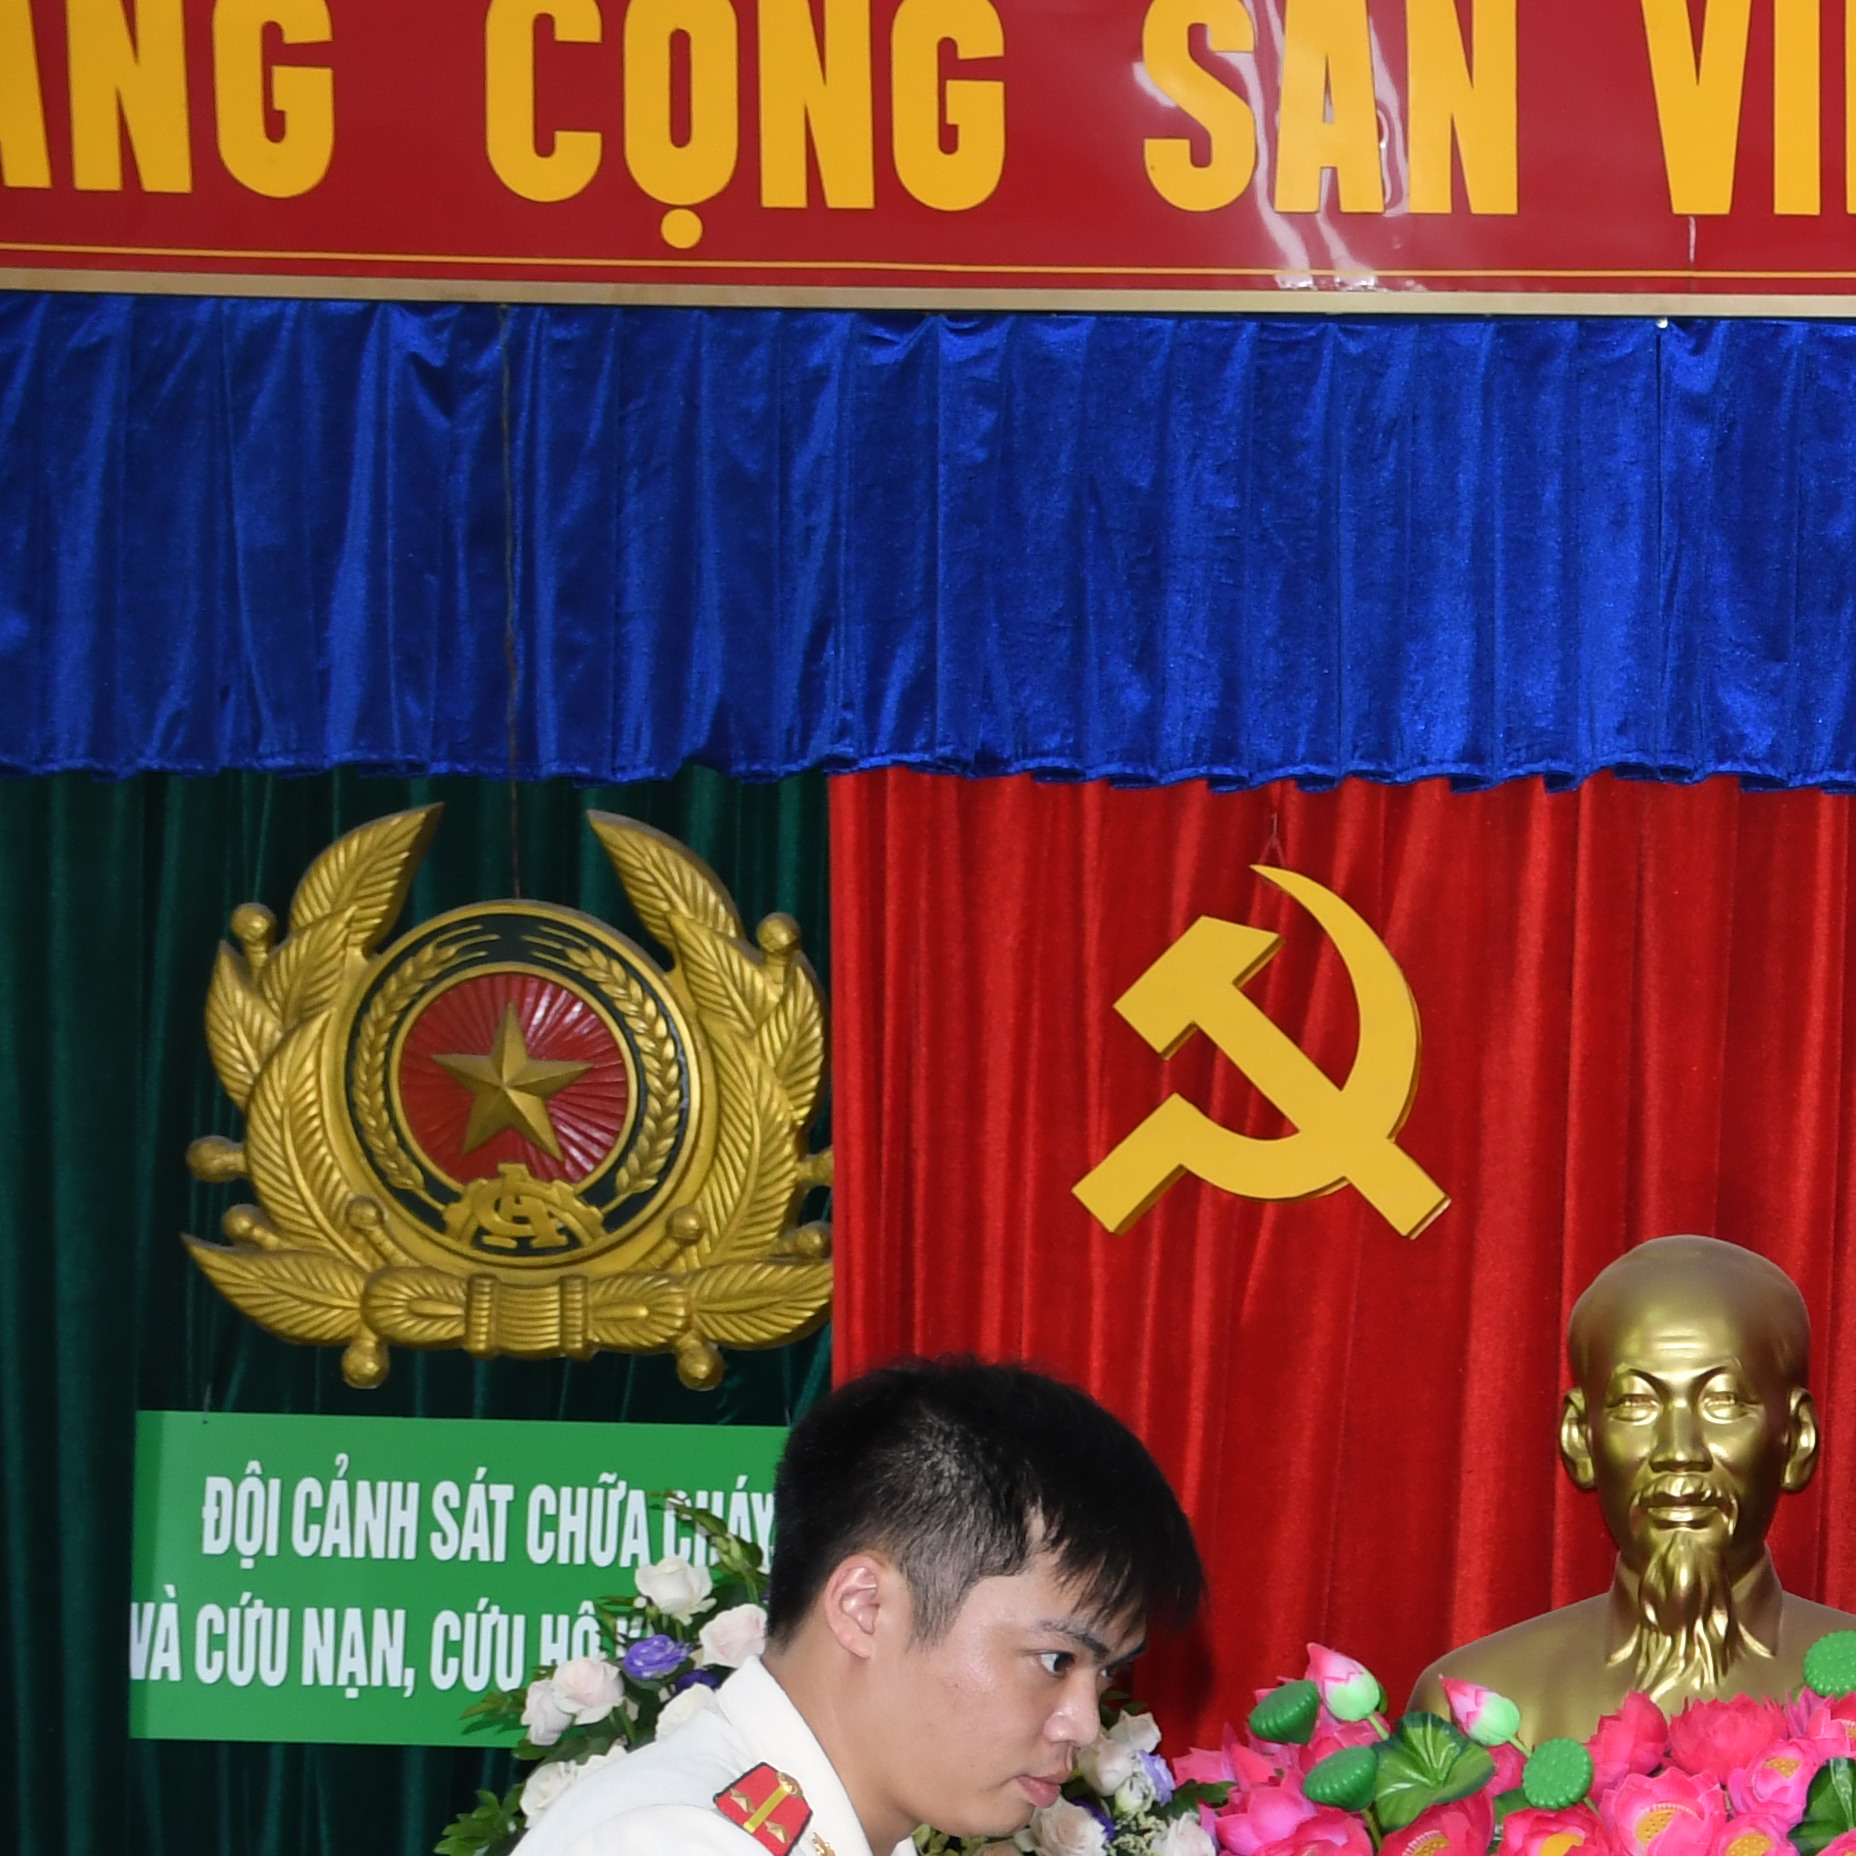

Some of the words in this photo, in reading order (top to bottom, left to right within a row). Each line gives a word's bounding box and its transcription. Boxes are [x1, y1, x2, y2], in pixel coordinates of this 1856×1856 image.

[201, 1459, 282, 1570] ĐỘI
[291, 1452, 419, 1562] CẢNH
[430, 1466, 515, 1564] SÁT
[526, 1471, 651, 1569] CHỮA
[129, 1583, 182, 1683] VÀ
[195, 1591, 290, 1688] CỨU
[301, 1606, 416, 1700] NẠN,
[430, 1597, 526, 1693] CỨU
